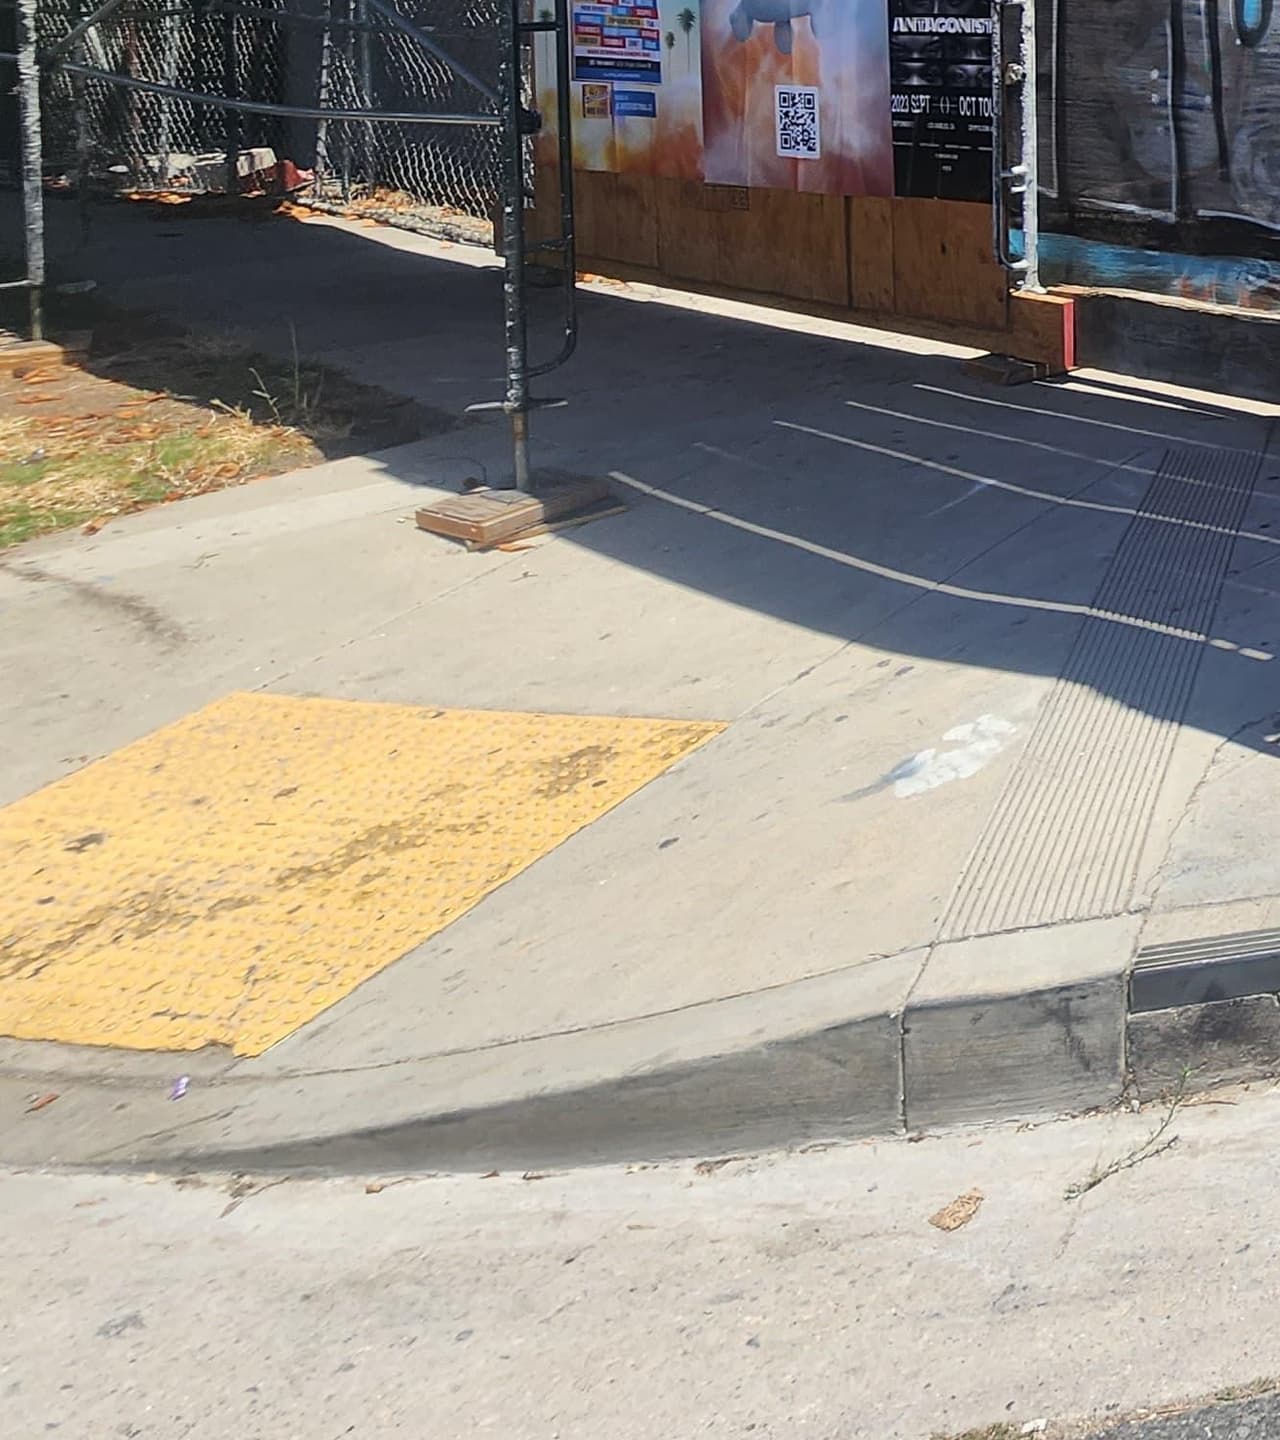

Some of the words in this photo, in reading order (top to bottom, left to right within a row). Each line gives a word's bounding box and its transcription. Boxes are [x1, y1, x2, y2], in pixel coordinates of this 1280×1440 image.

[891, 94, 909, 113] 2023
[910, 95, 931, 113] SEPT
[958, 95, 976, 117] OCT
